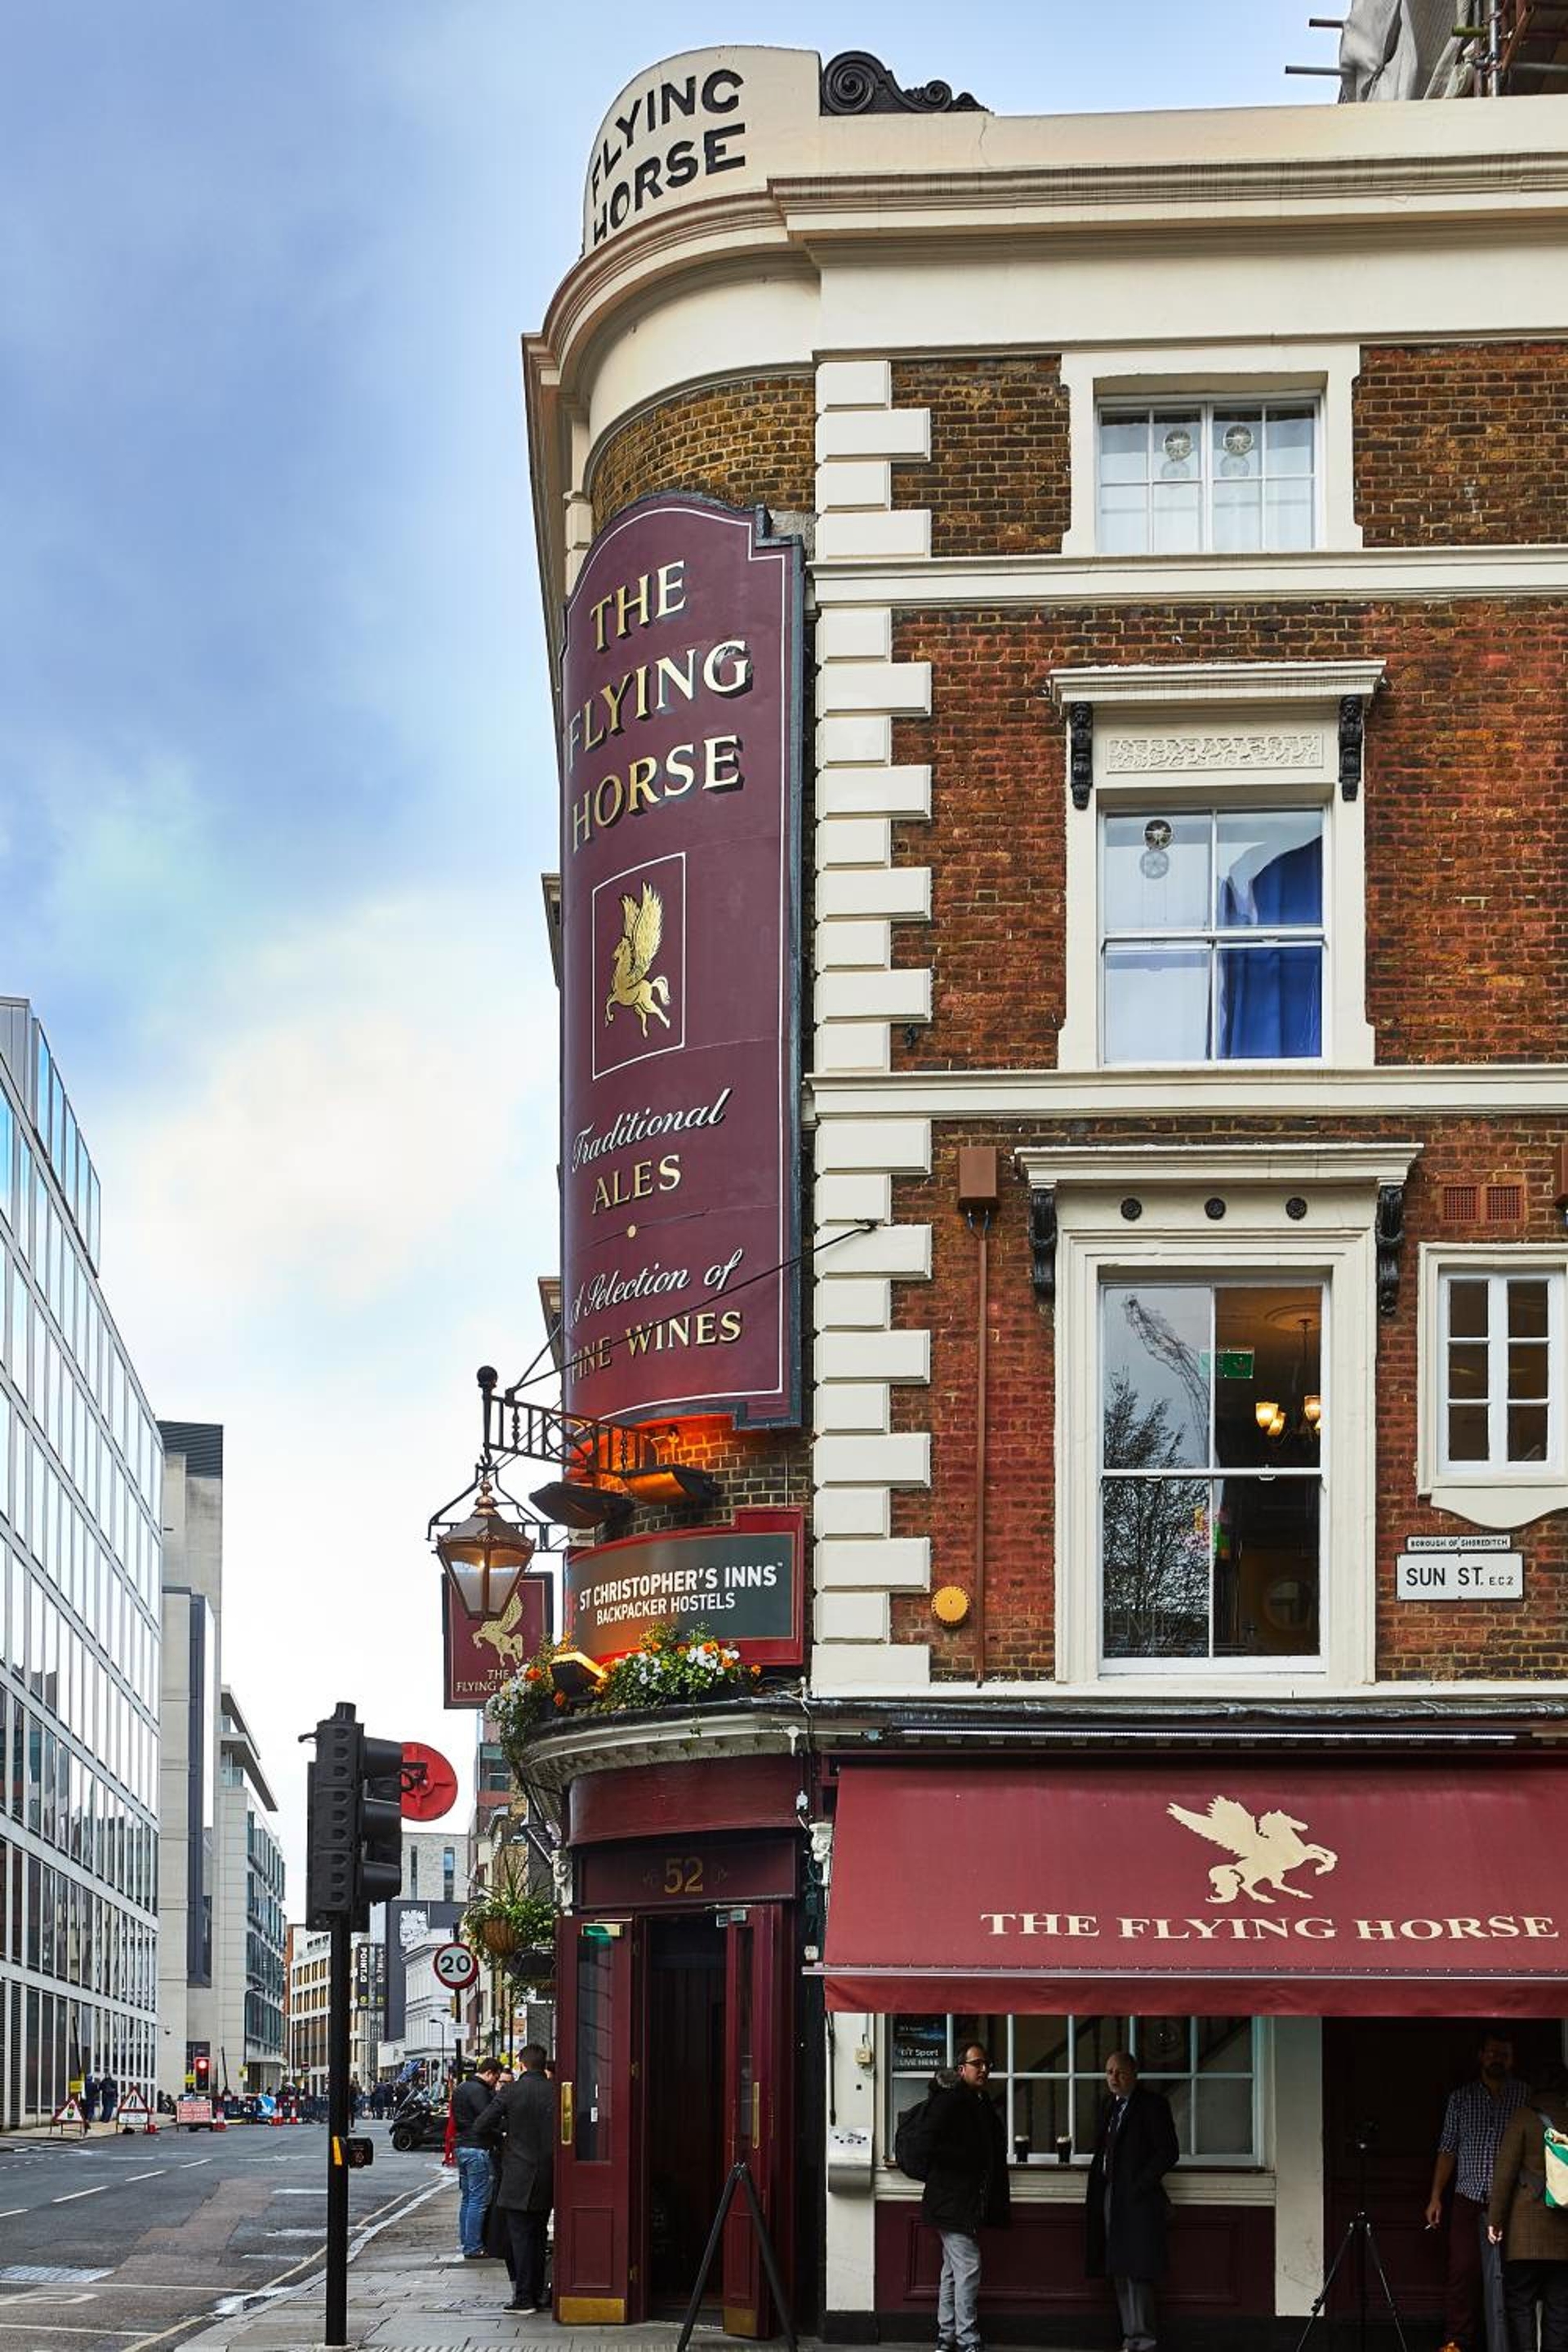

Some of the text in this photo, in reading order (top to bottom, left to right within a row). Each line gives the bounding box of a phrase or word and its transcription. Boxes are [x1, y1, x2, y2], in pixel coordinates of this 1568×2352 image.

[592, 69, 744, 207] FLYING
[594, 122, 746, 247] HORSE
[590, 560, 687, 653] THE
[569, 640, 751, 773] FLYING
[572, 735, 743, 853] HORSE
[572, 1088, 733, 1174] Traditional
[591, 1154, 683, 1215] ALES
[584, 1262, 691, 1316] Selection
[703, 1248, 744, 1290] of
[571, 1310, 743, 1386] FINE WINES
[1410, 1539, 1508, 1548] BOROUGH OF SHOREDITCH
[579, 1564, 778, 1612] ST CHRISTOPHER'S INNS
[1405, 1567, 1446, 1587] SUN
[1457, 1566, 1485, 1586] ST.
[596, 1592, 737, 1626] BACKPACKER HOSTELS
[457, 1681, 497, 1692] FLYING
[487, 1669, 510, 1680] THE
[664, 1857, 704, 1894] 52
[980, 1913, 1560, 1940] THE FLYING HORSE
[441, 1955, 471, 1973] 20
